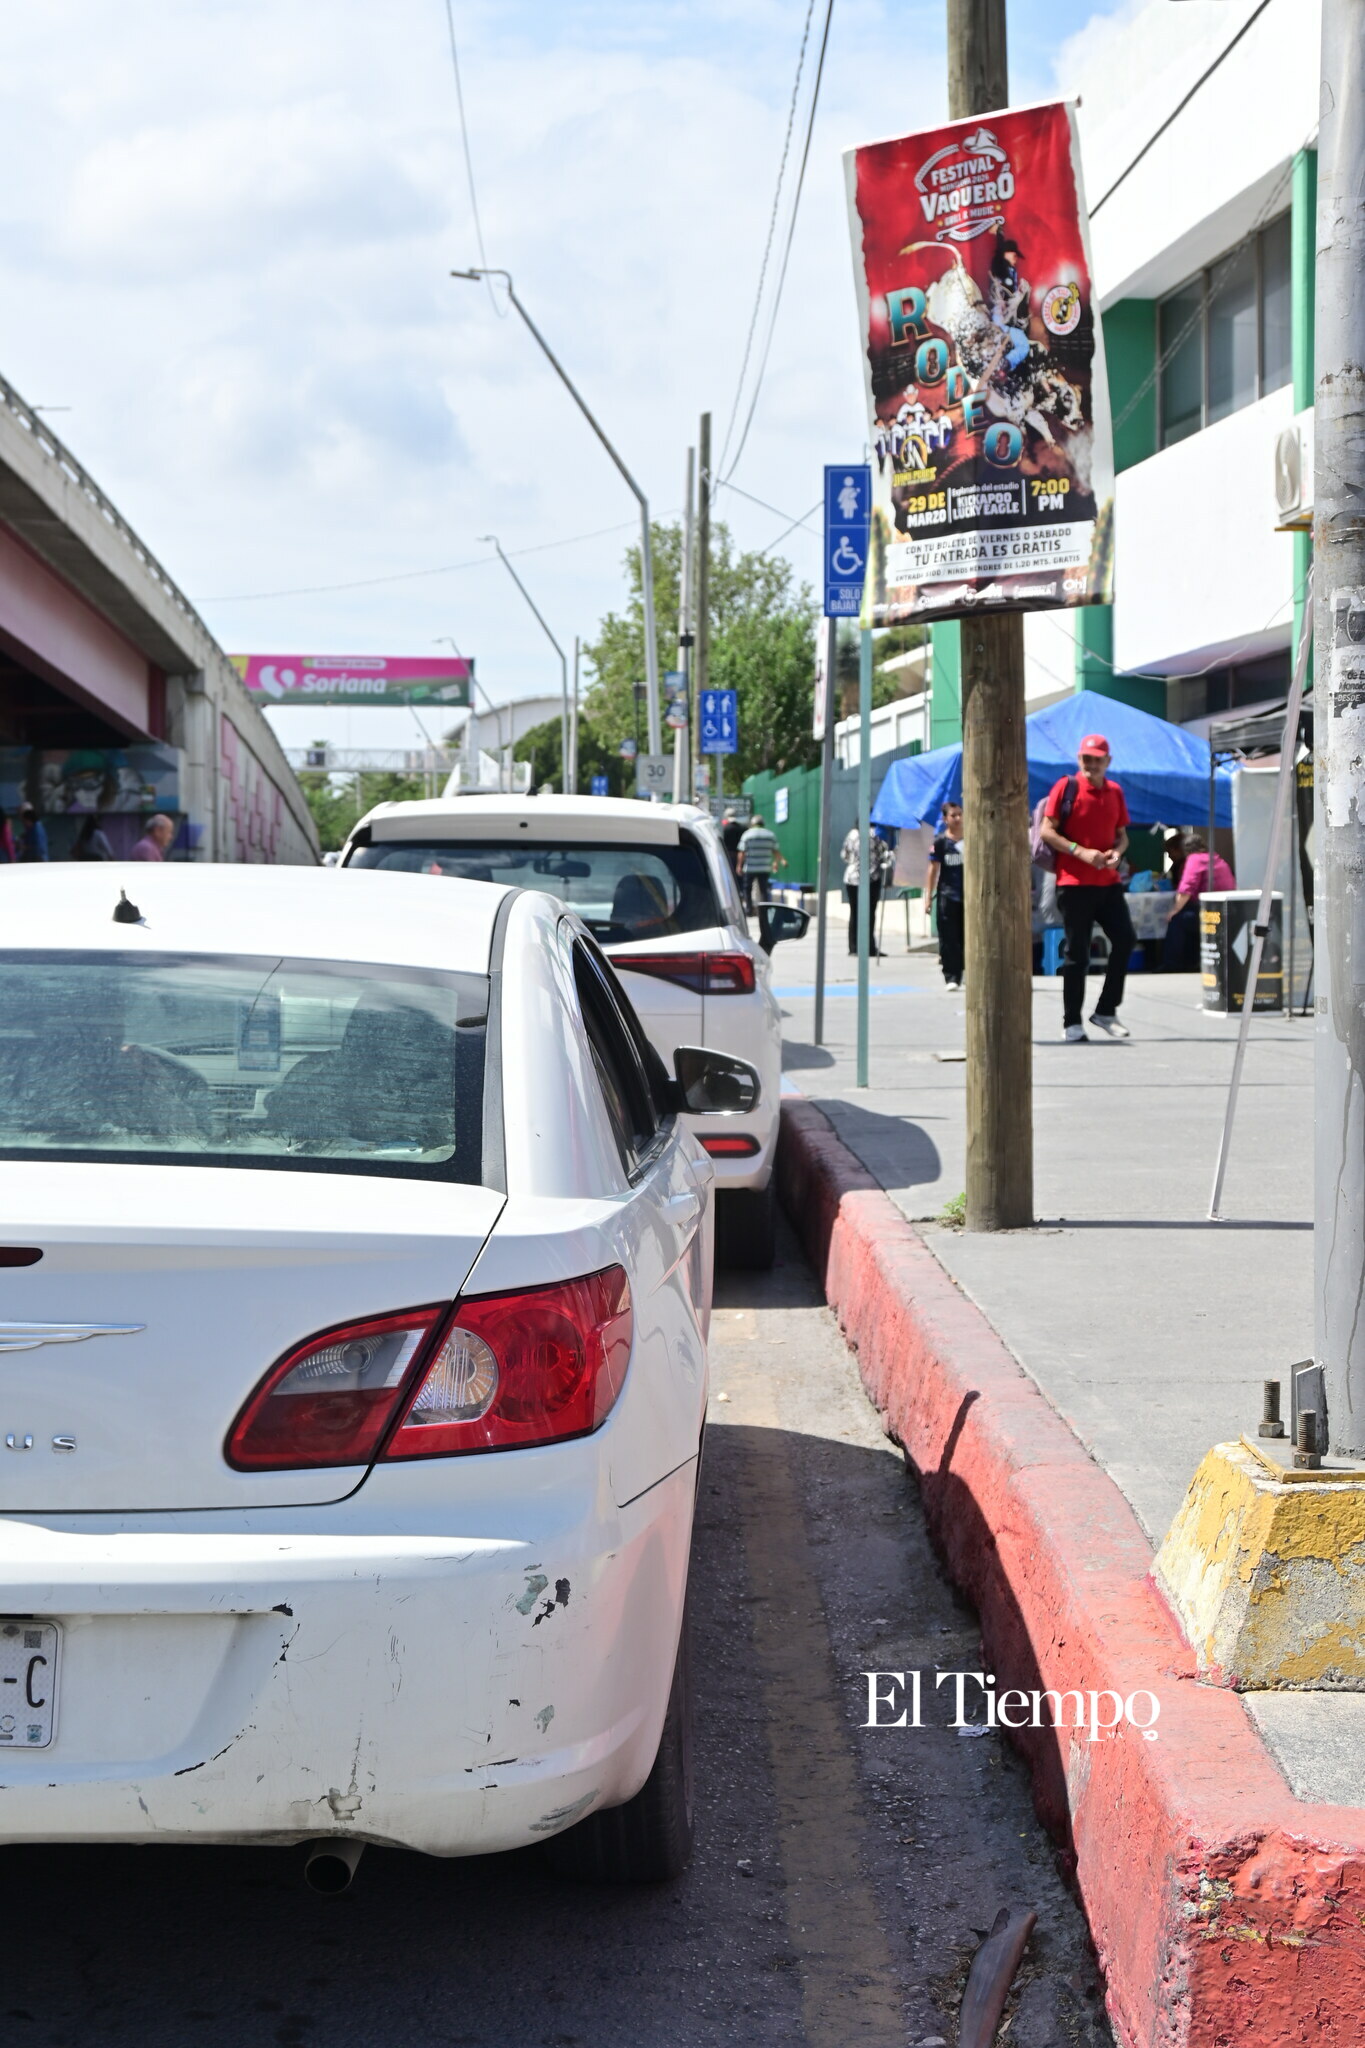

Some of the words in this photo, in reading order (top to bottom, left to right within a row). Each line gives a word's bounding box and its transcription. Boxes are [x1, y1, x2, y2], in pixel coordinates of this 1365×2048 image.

[931, 155, 995, 187] FESTIVAL
[981, 482, 993, 492] del
[993, 481, 1020, 491] estadio
[1031, 477, 1070, 497] 7:00
[908, 495, 927, 514] 29
[928, 491, 946, 510] DE
[957, 492, 1012, 508] KICKAPOO
[1038, 494, 1064, 511] PM
[906, 508, 947, 529] MARZO
[952, 504, 983, 520] LUCKY
[983, 501, 1020, 516] EAGLE
[906, 545, 922, 555] CON
[924, 543, 935, 552] TU
[936, 538, 967, 550] BOLETO
[968, 537, 977, 546] DE
[979, 532, 1020, 544] VIERNES
[1024, 531, 1030, 540] O
[914, 553, 930, 567] TU
[934, 545, 987, 563] ENTRADA
[992, 544, 1008, 557] ES
[1012, 539, 1061, 555] GRATIS
[840, 588, 861, 600] SOLO
[301, 672, 387, 695] Soriana
[1337, 694, 1361, 702] DESDE
[647, 764, 666, 778] 30
